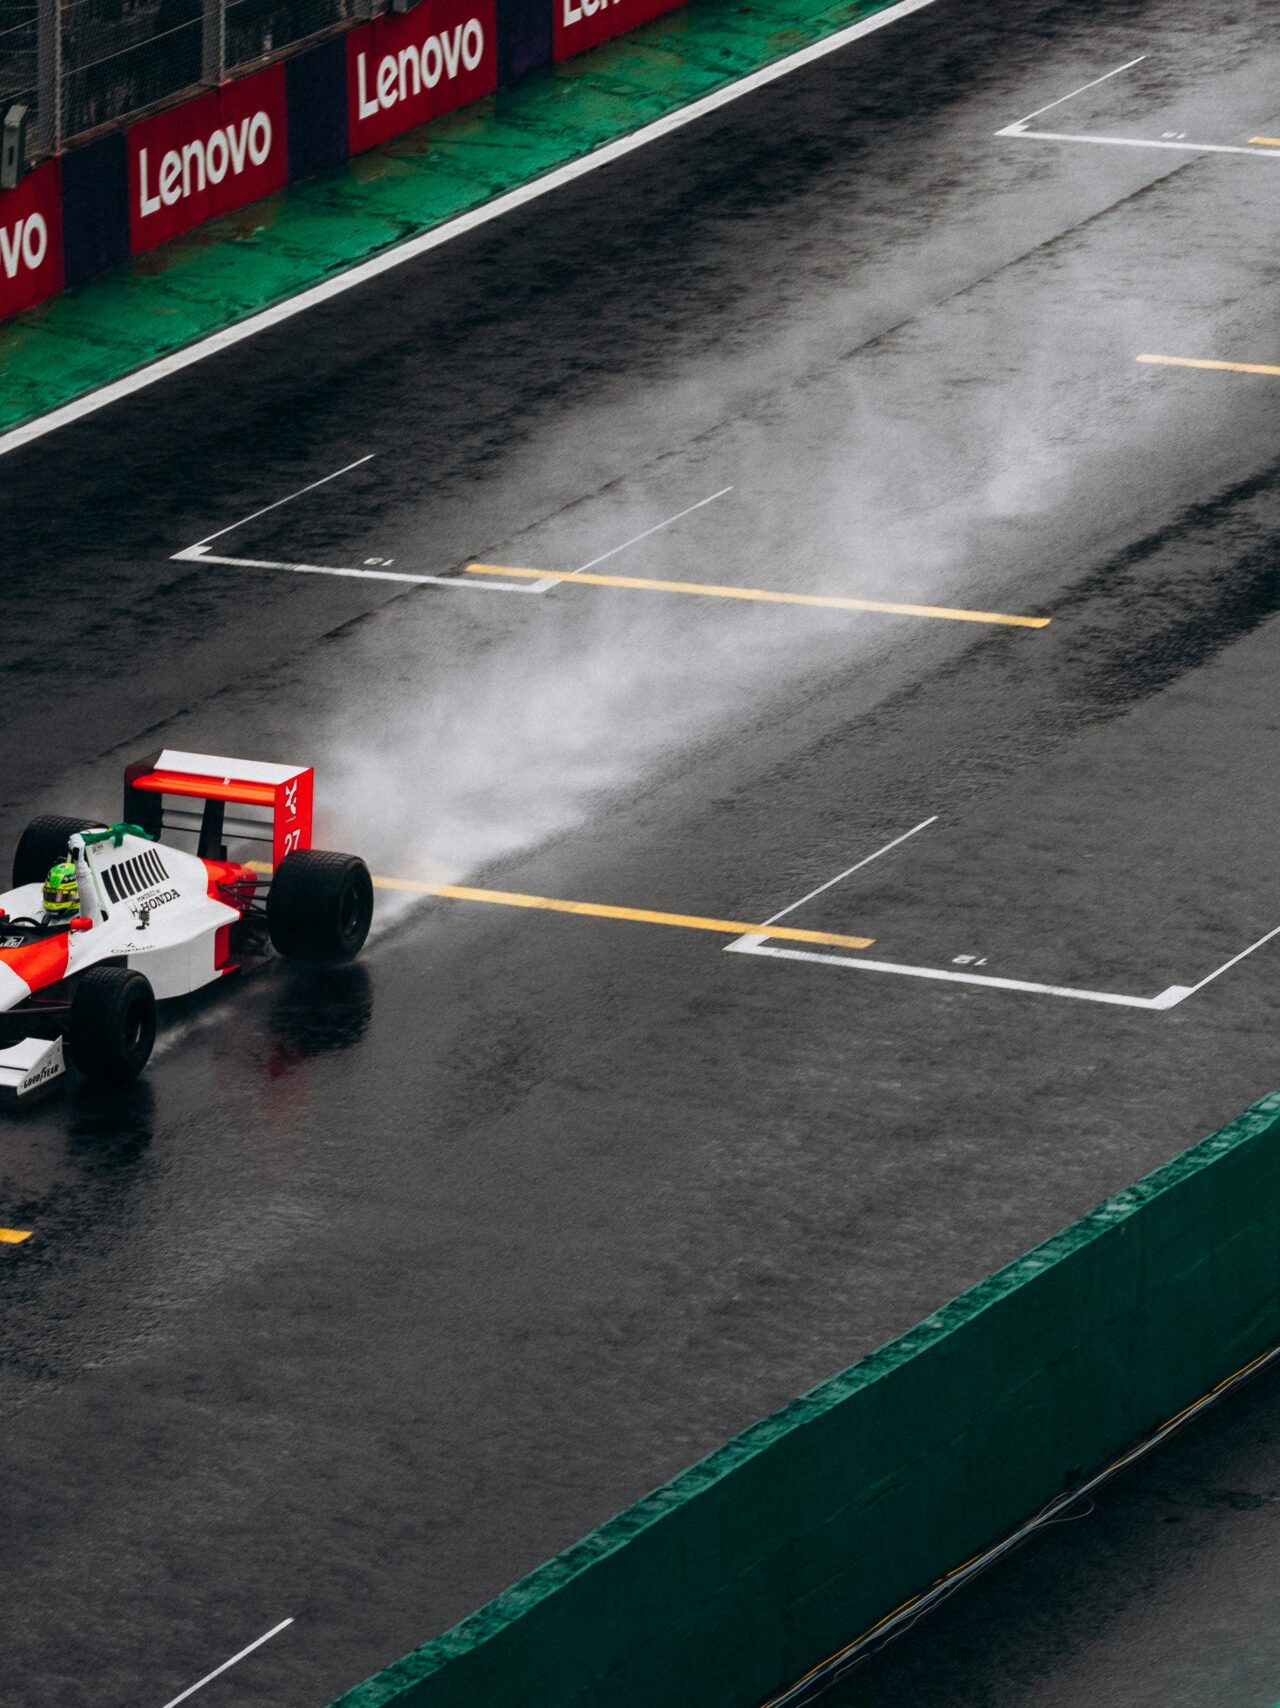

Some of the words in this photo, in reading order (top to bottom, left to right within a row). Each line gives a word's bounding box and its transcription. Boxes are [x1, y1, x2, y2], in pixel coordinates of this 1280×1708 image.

[357, 18, 484, 120] Lenovo
[139, 111, 272, 218] Lenovo
[284, 828, 301, 857] 27
[140, 888, 181, 913] HONDA
[951, 954, 988, 966] 12
